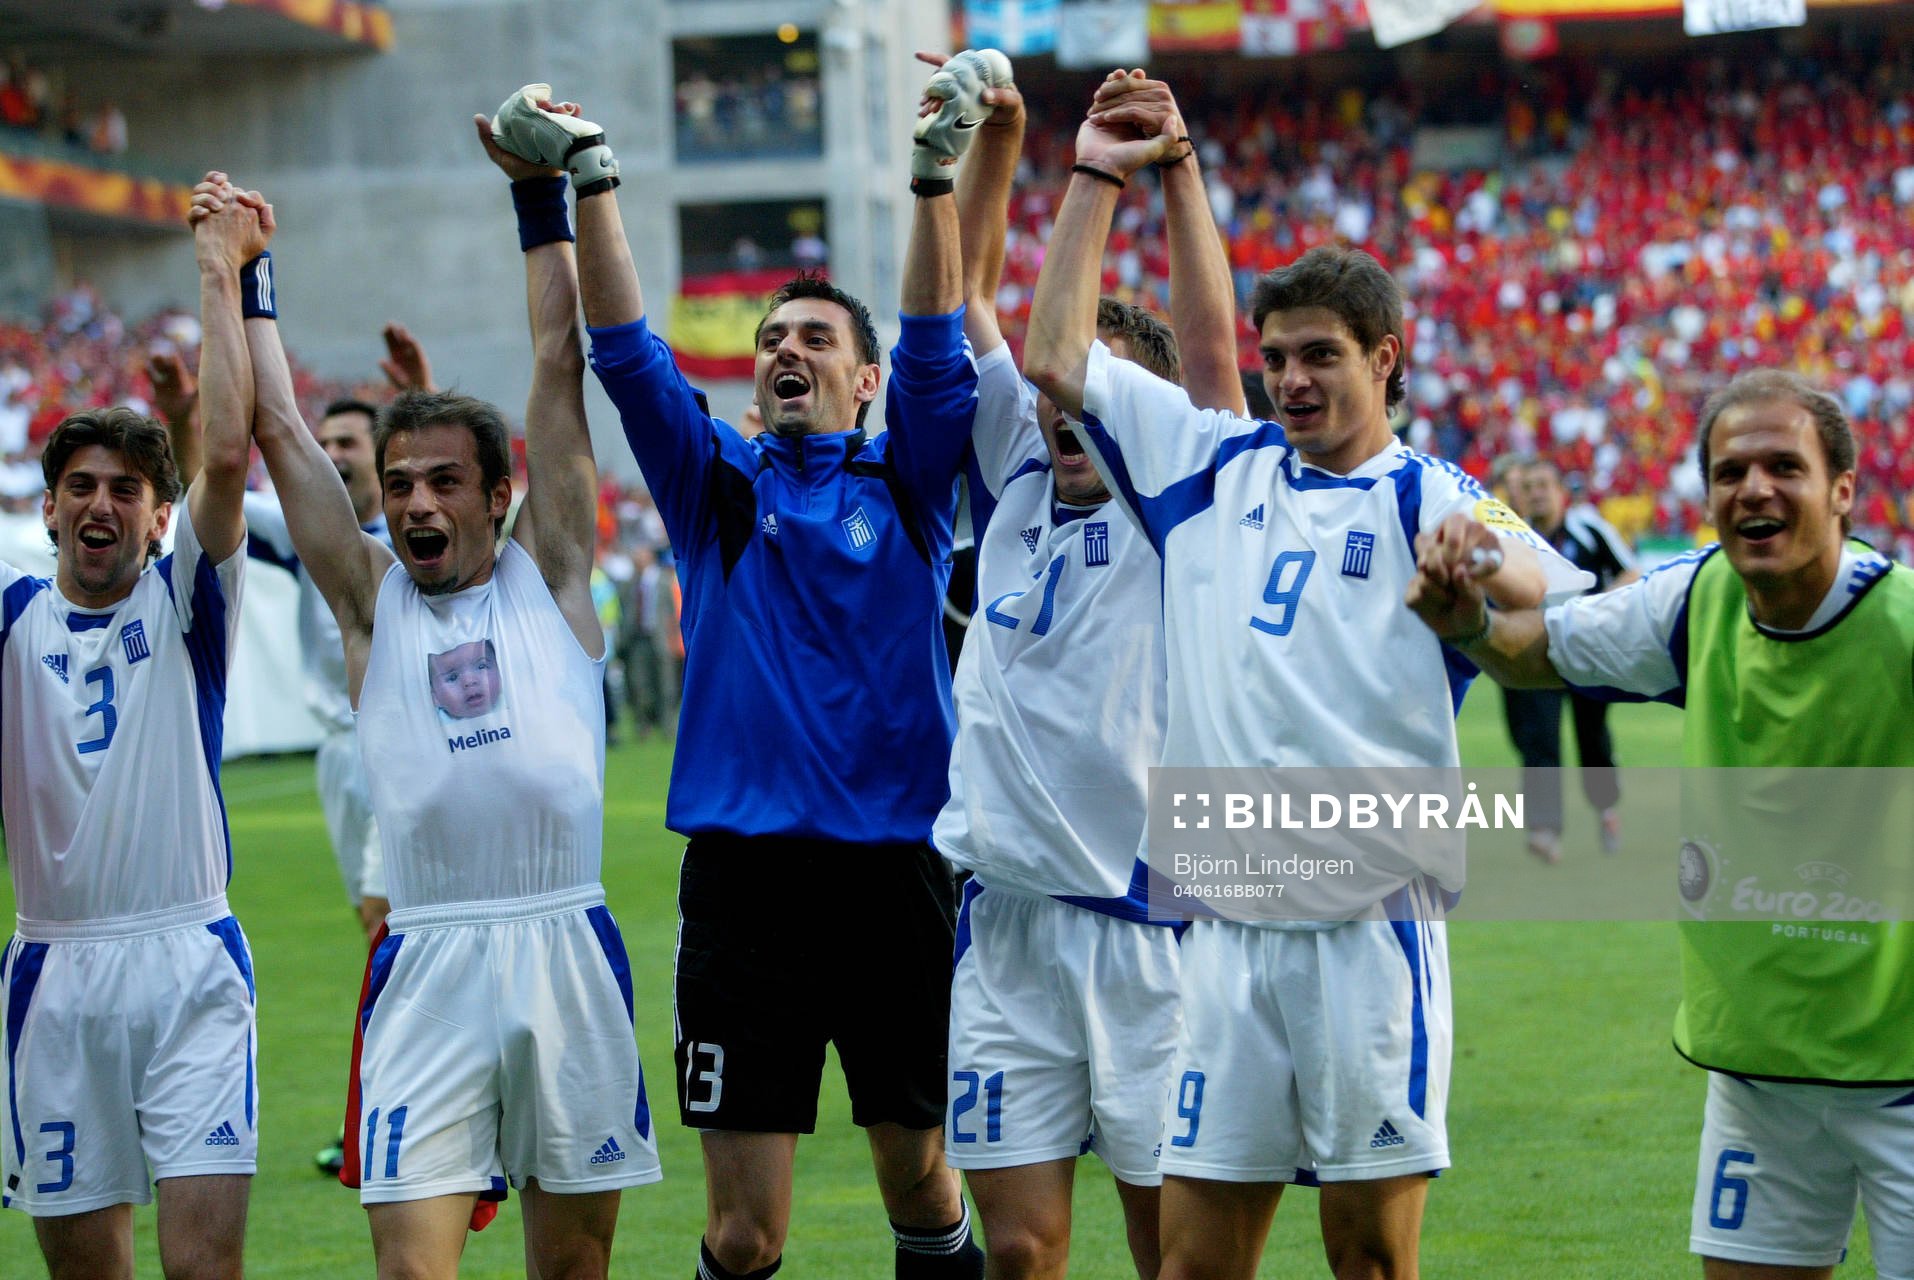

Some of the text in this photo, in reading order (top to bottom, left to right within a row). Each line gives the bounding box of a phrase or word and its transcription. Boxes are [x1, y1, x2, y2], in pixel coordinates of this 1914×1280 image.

[1249, 550, 1316, 637] 9
[76, 665, 118, 754] 3
[448, 726, 512, 753] Melina
[1732, 876, 1819, 918] Euro
[1772, 923, 1870, 944] PORTUGAL
[685, 1040, 725, 1113] 13
[953, 1070, 1004, 1143] 21
[1171, 1070, 1206, 1147] 9
[37, 1121, 75, 1193] 3
[205, 1134, 240, 1146] adidas
[364, 1105, 408, 1181] 11
[590, 1151, 626, 1164] adidas
[1709, 1148, 1756, 1230] 6
